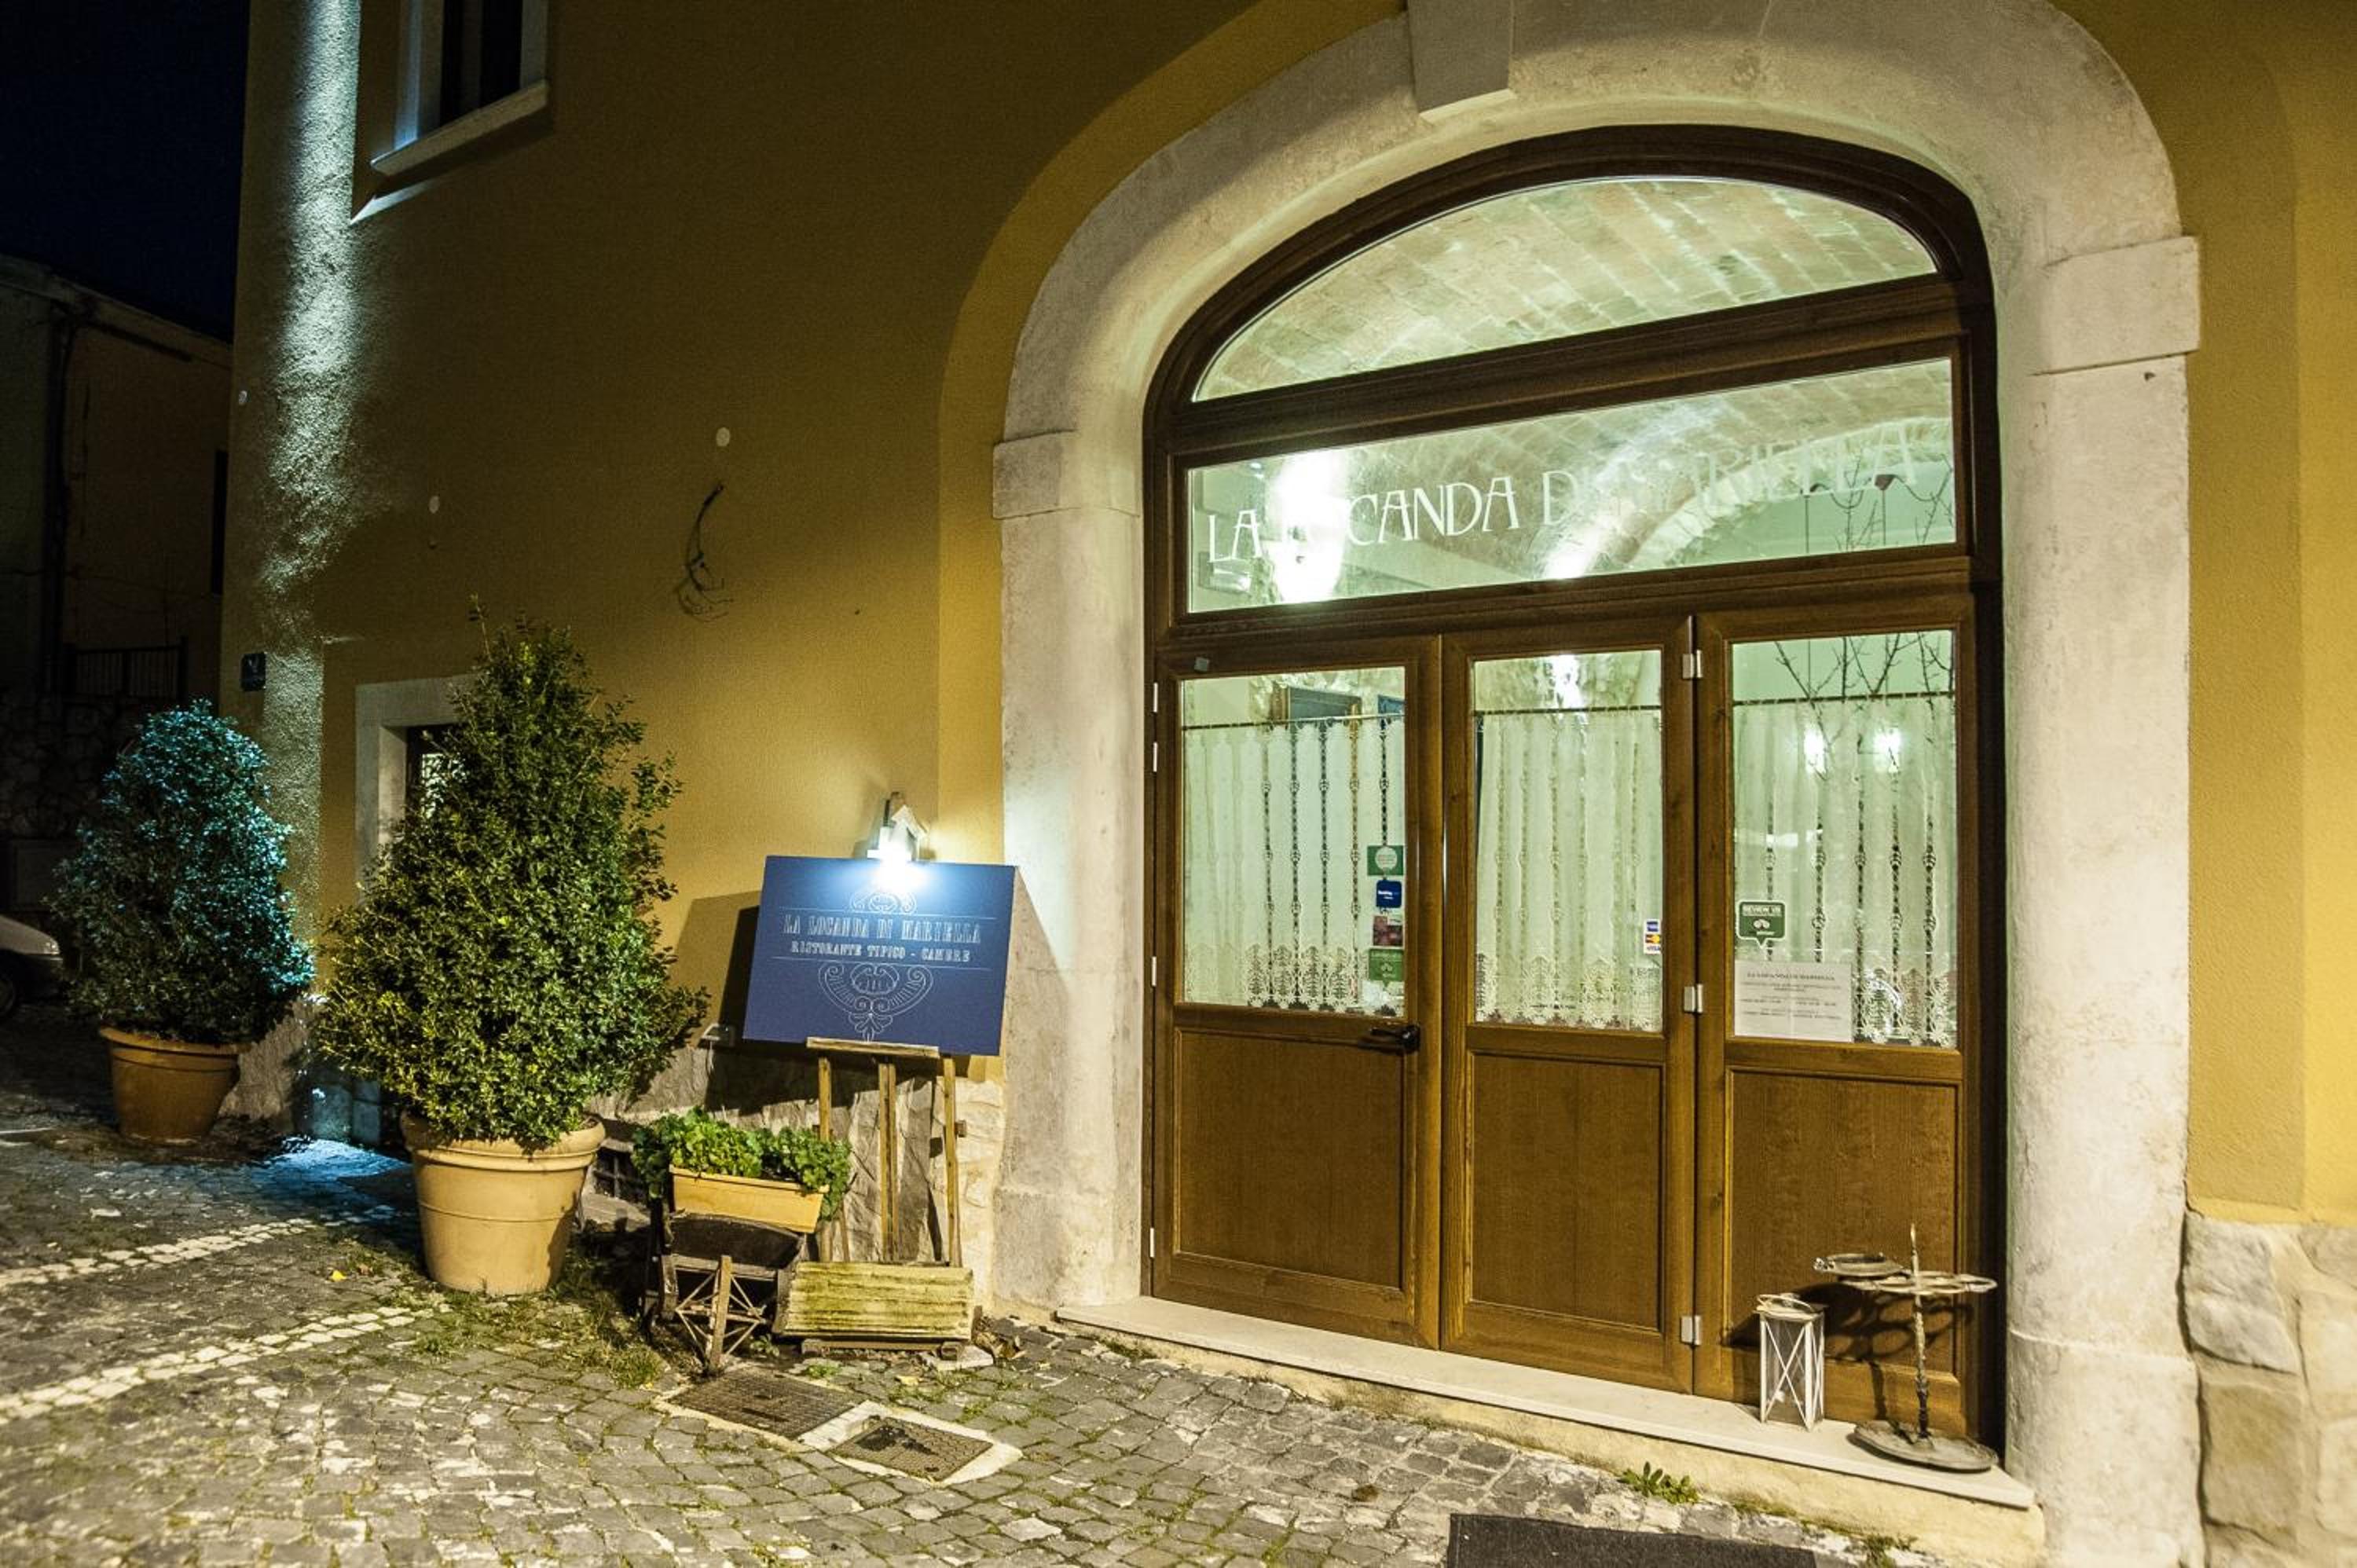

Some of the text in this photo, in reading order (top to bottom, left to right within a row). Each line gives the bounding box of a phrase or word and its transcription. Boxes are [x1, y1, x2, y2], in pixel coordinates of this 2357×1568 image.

[1208, 509, 1263, 562] LA
[1273, 476, 1519, 555] CANDA
[782, 914, 801, 934] LA
[807, 916, 870, 938] LOCANDA
[877, 918, 894, 940] DI
[790, 940, 862, 956] RISTORANTE
[867, 944, 906, 959] TIPICO
[921, 947, 970, 962] CAMERE
